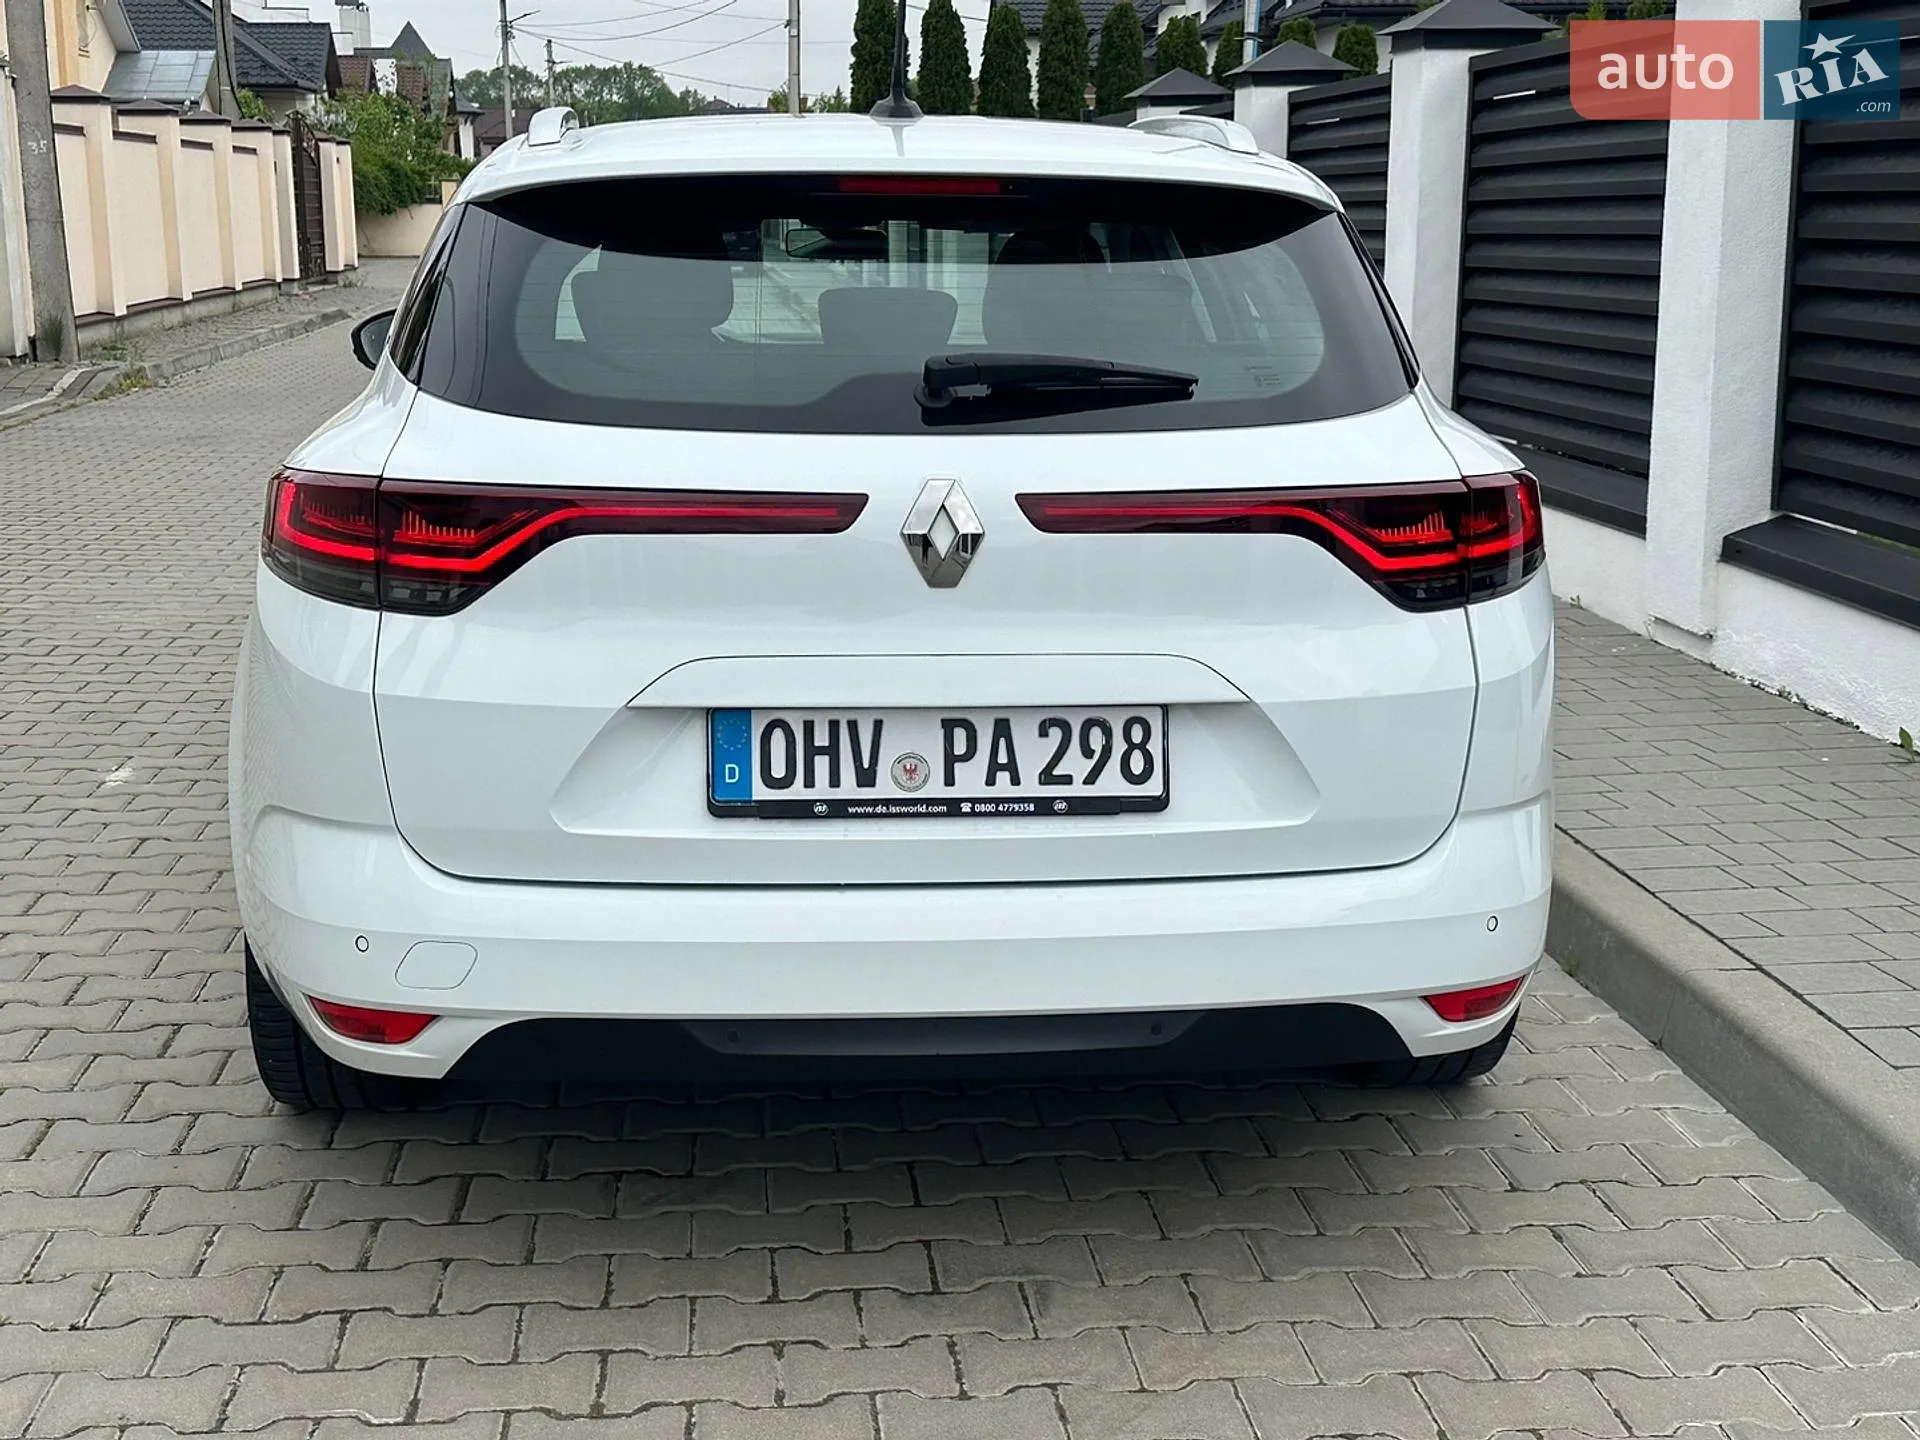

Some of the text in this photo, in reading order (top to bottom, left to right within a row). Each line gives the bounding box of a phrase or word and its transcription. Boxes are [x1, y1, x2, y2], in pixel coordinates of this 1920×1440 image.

[760, 716, 1155, 789] OHV PA 298
[725, 764, 739, 783] D
[847, 803, 947, 814] www.de.issworld.com
[974, 803, 996, 812] 0800
